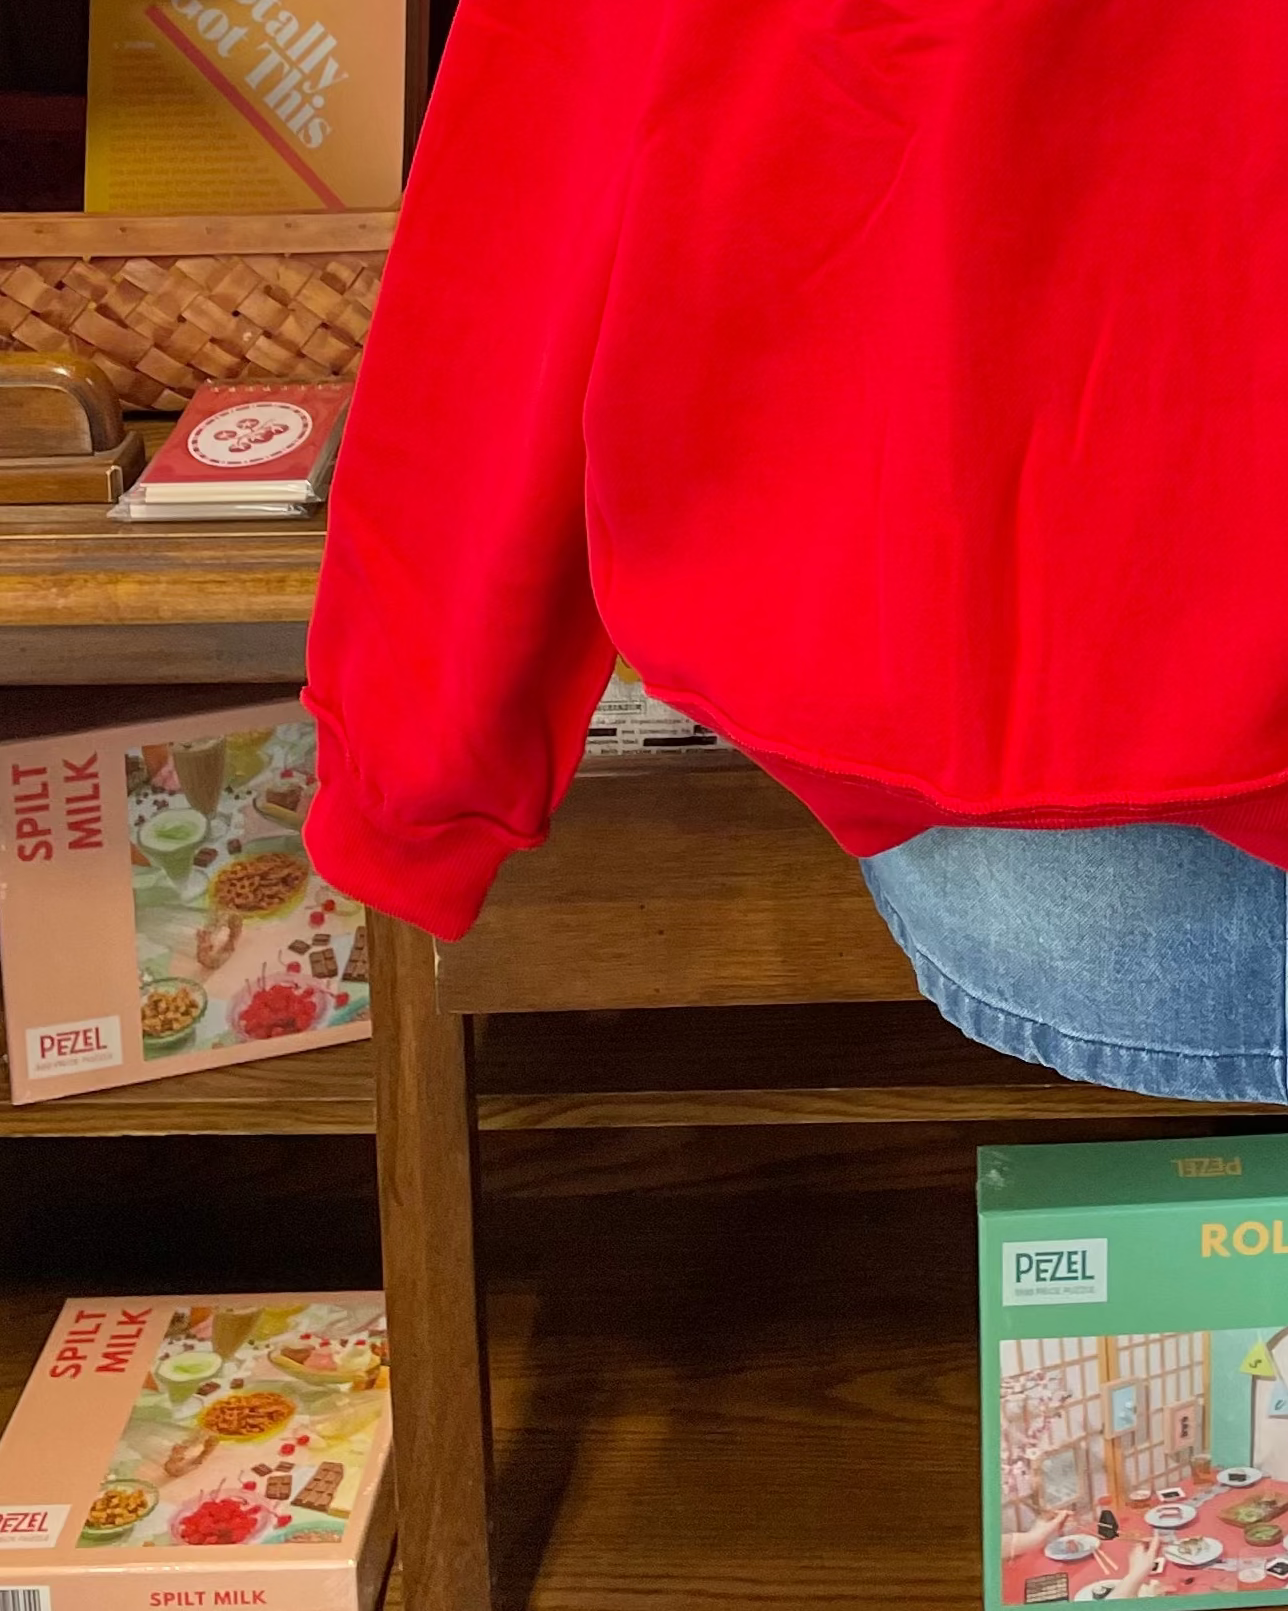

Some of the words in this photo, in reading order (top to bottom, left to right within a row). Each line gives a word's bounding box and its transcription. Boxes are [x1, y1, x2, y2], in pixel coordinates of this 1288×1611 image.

[244, 41, 332, 148] This
[11, 763, 53, 862] SPILT
[62, 750, 104, 850] MILK
[39, 1026, 108, 1059] PEZEL
[1170, 1156, 1243, 1178] PEZEL
[1015, 1250, 1095, 1283] PEZEL
[49, 1310, 107, 1380] SPILT
[94, 1307, 153, 1373] MILK
[0, 1511, 48, 1533] EZEL
[150, 1591, 206, 1607] SPILT
[214, 1590, 267, 1606] MILK
